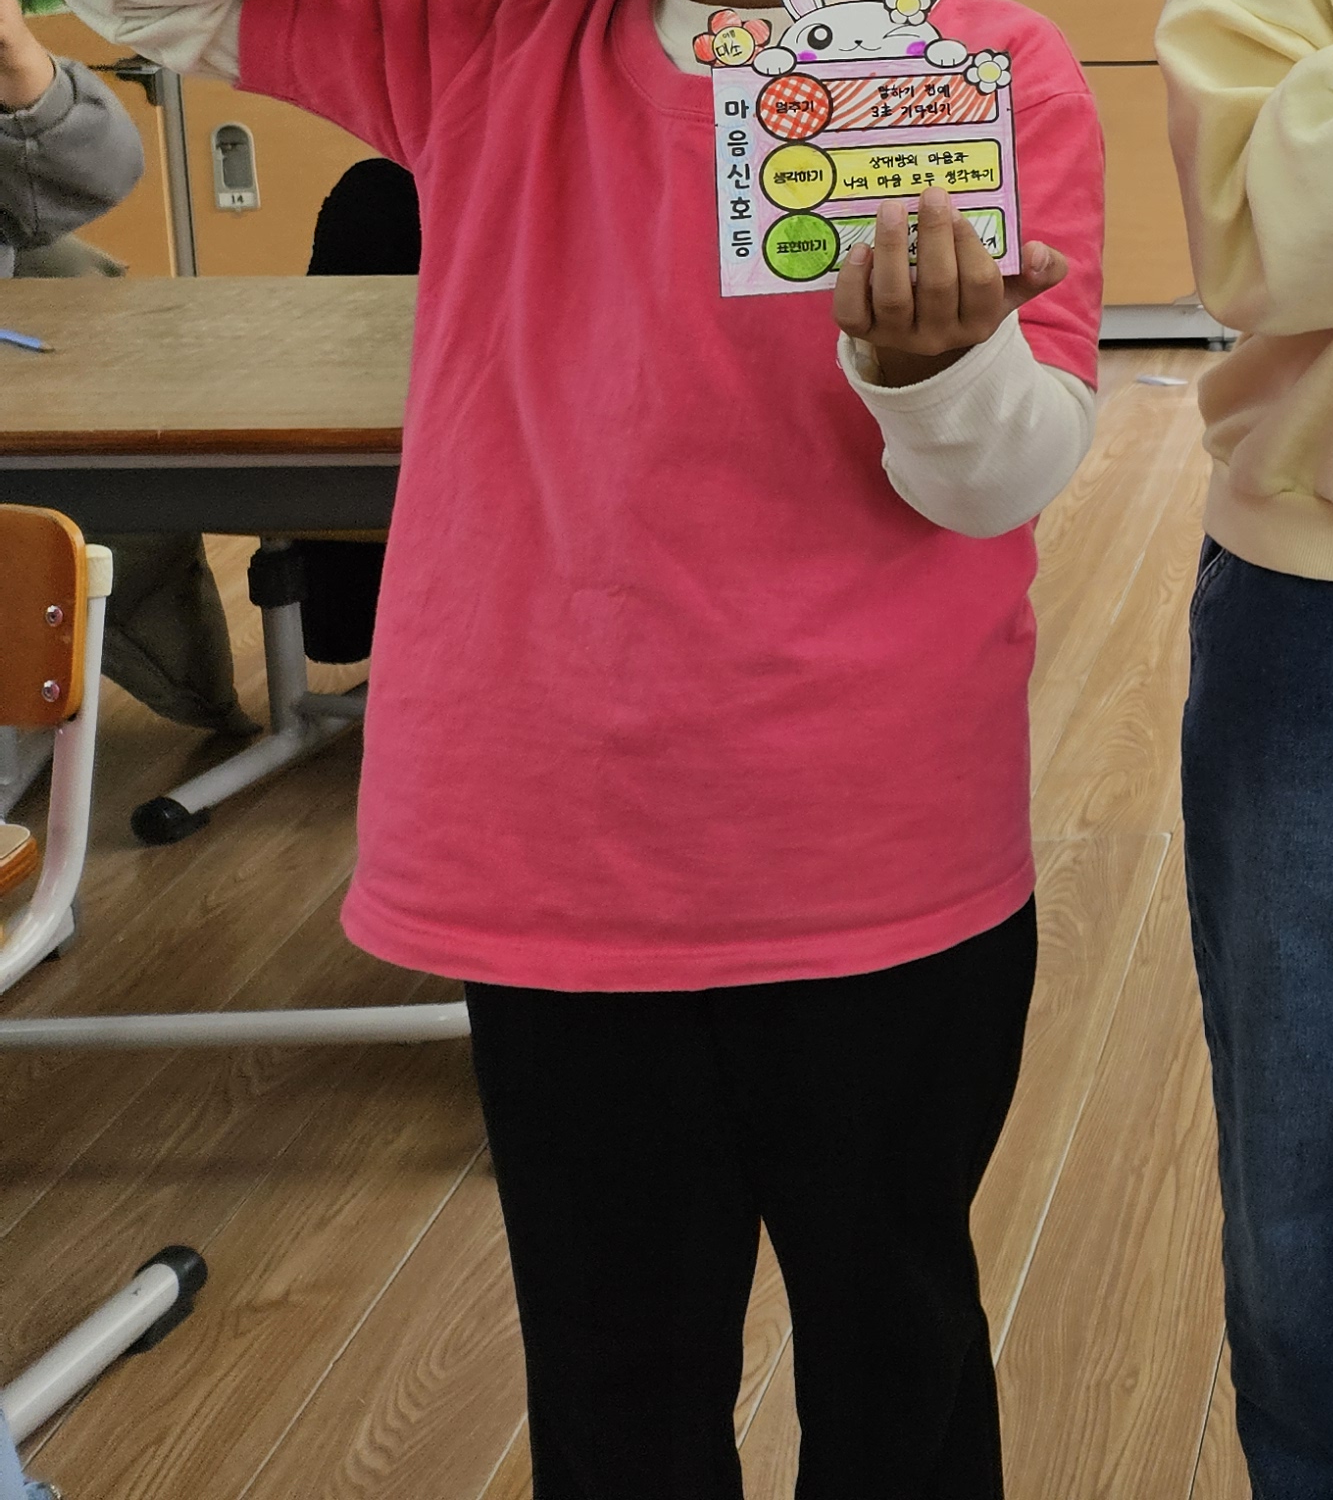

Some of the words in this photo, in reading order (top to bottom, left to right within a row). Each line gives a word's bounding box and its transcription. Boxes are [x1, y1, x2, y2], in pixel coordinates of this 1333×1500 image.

[775, 100, 814, 114] 멈추기
[724, 99, 753, 258] 마음신호등
[773, 171, 824, 184] 생각하기
[877, 173, 902, 188] 마음
[911, 172, 935, 186] 모두
[776, 240, 827, 254] 표현하기
